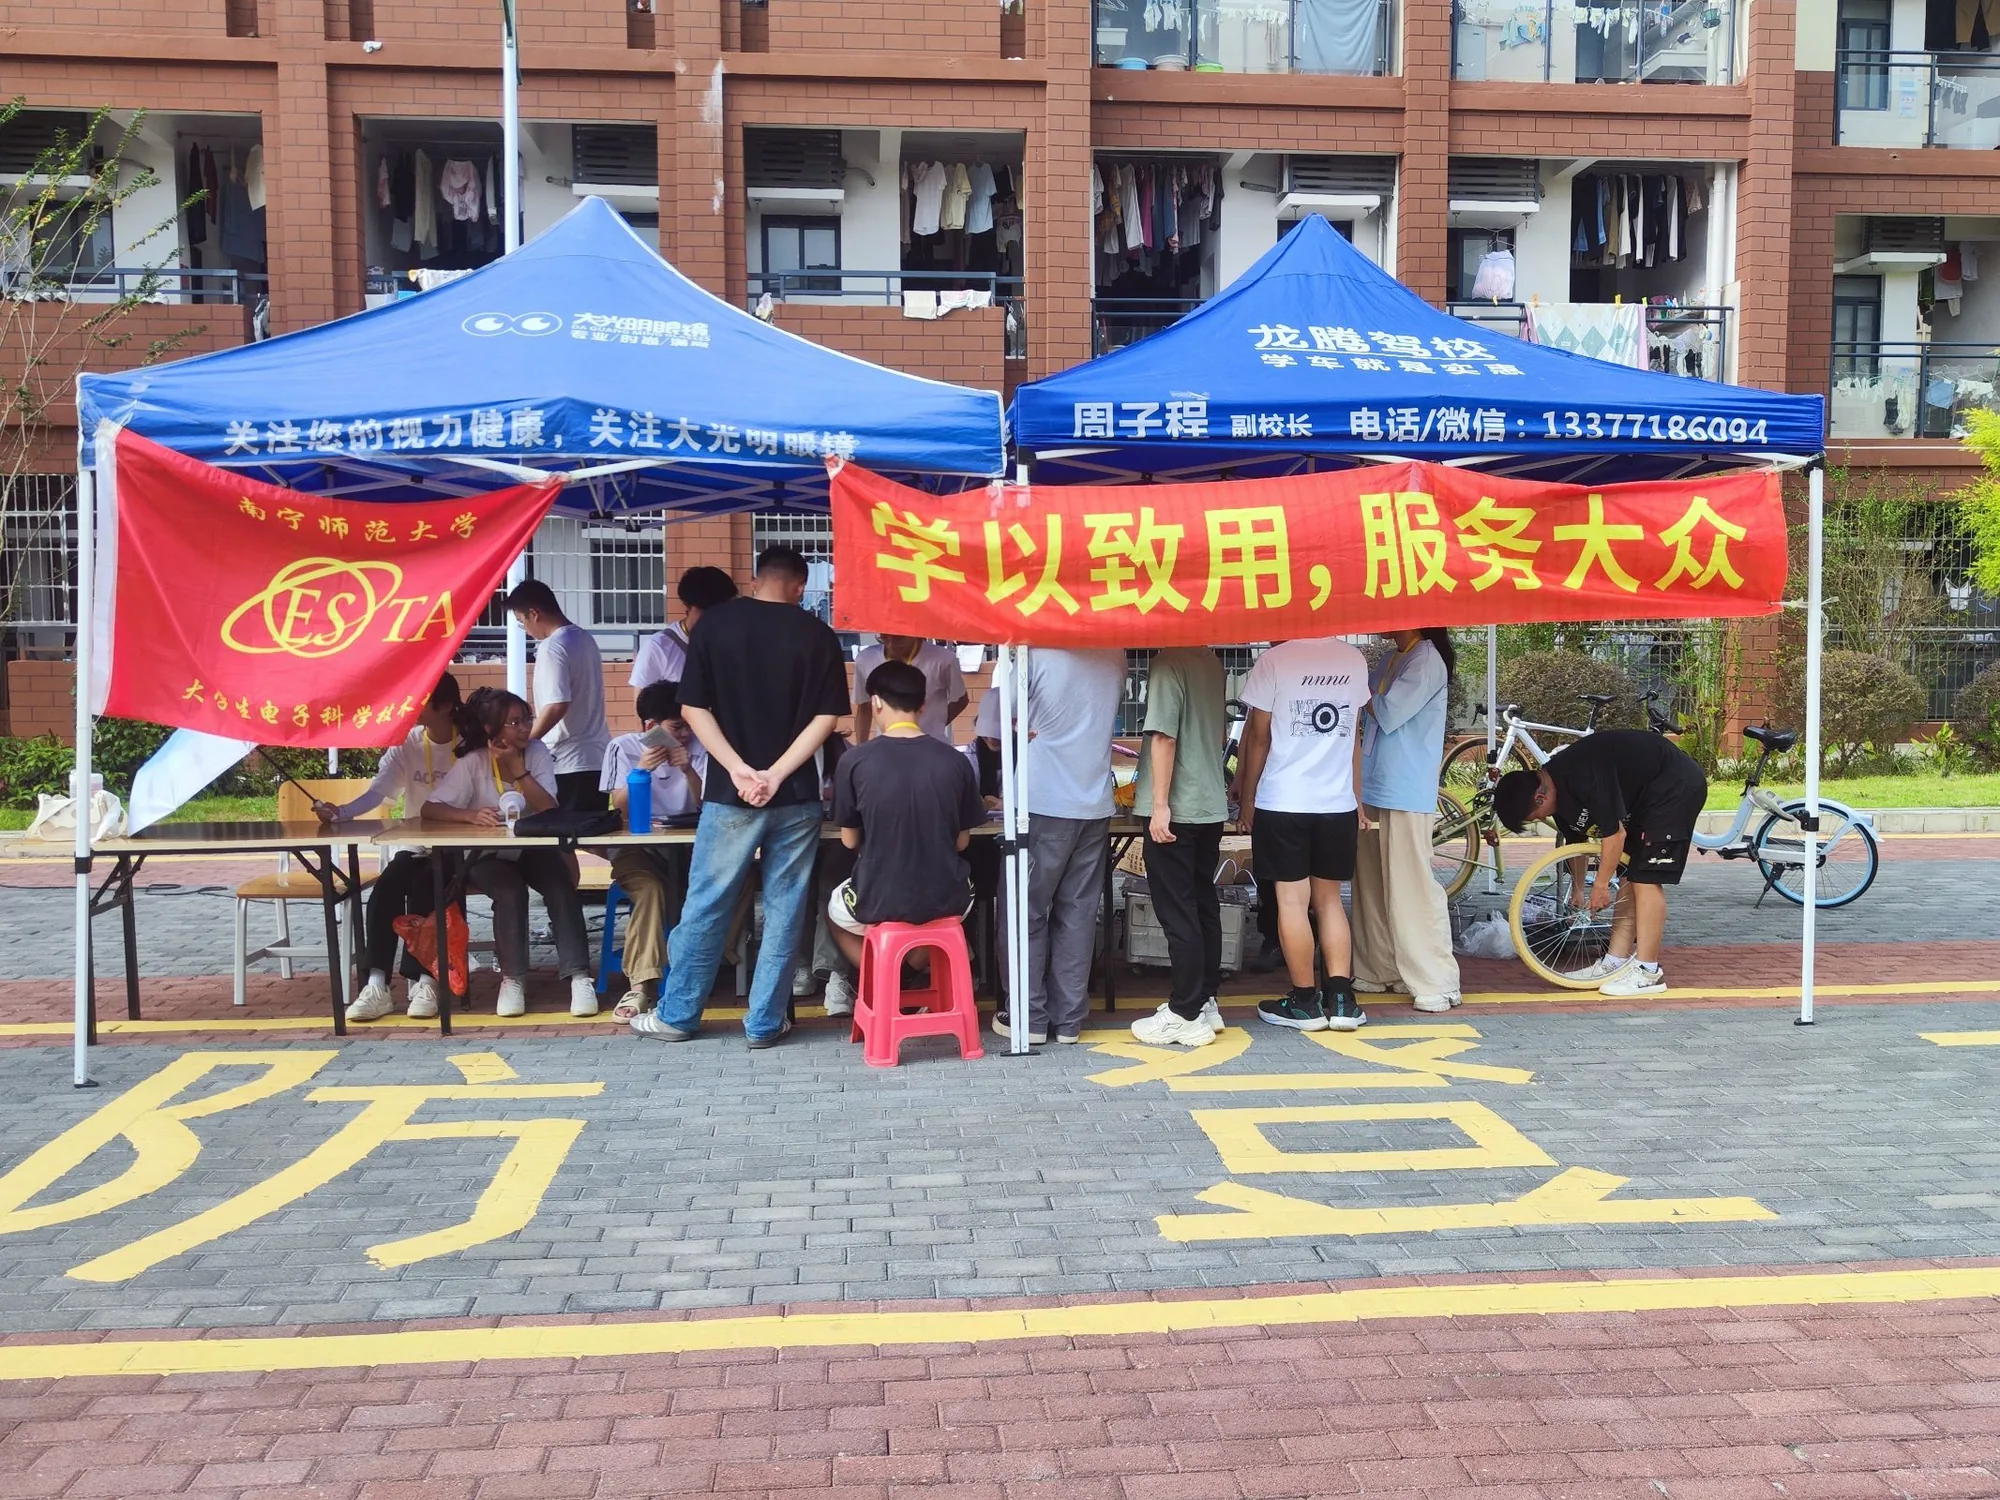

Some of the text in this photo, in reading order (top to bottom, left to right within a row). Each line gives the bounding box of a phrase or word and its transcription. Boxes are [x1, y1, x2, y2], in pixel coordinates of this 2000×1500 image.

[1248, 324, 1497, 359] 龙腾驾校
[1260, 353, 1526, 376] 学车就是实惠
[1073, 401, 1210, 438] 周子程
[1231, 412, 1313, 438] 副校长
[238, 496, 478, 543] 南宁师范大学
[869, 491, 1749, 617] 学以致用，服务大众
